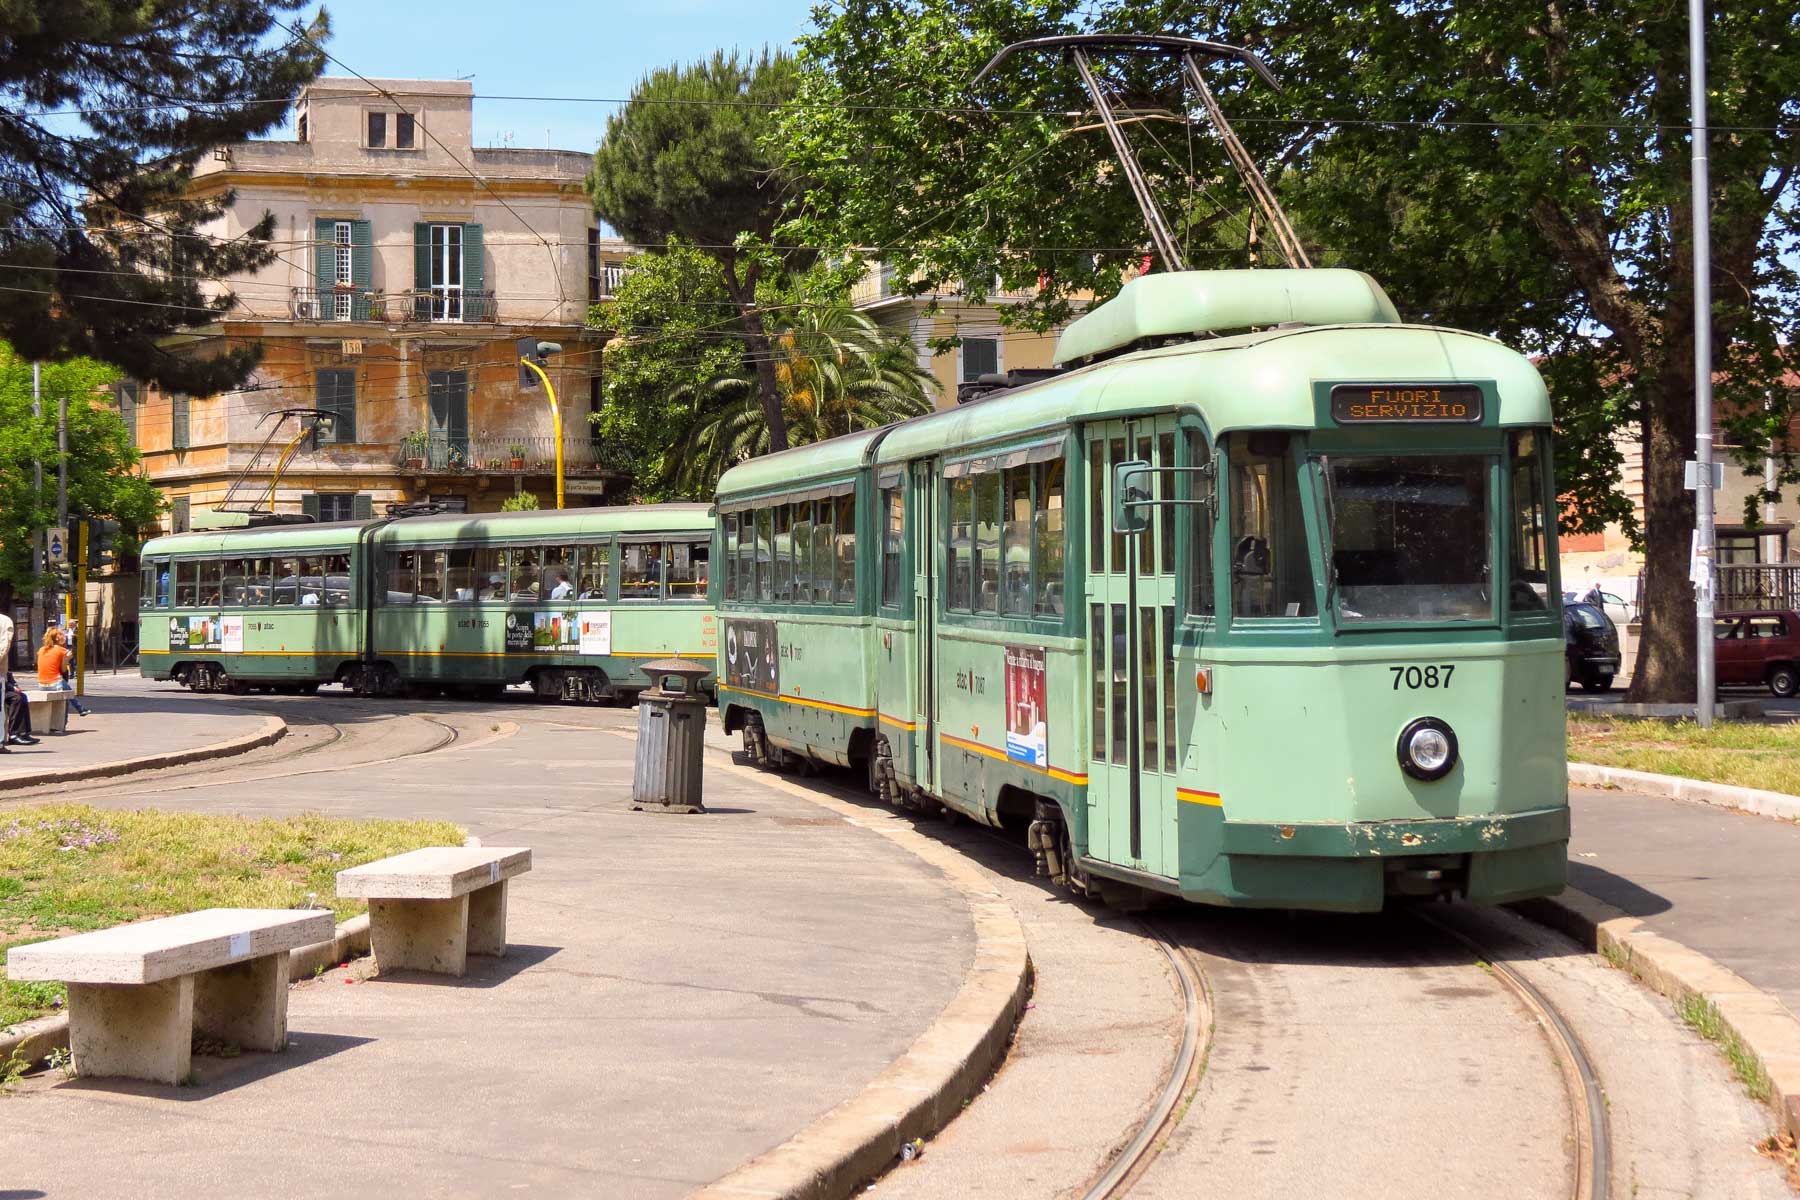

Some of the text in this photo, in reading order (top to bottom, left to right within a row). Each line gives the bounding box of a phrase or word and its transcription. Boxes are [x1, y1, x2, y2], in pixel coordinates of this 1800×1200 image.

[1371, 390, 1441, 403] FUORI
[1350, 404, 1466, 417] SERVIZIO
[780, 642, 788, 658] atac
[957, 667, 968, 690] atac
[1390, 664, 1455, 691] 7087
